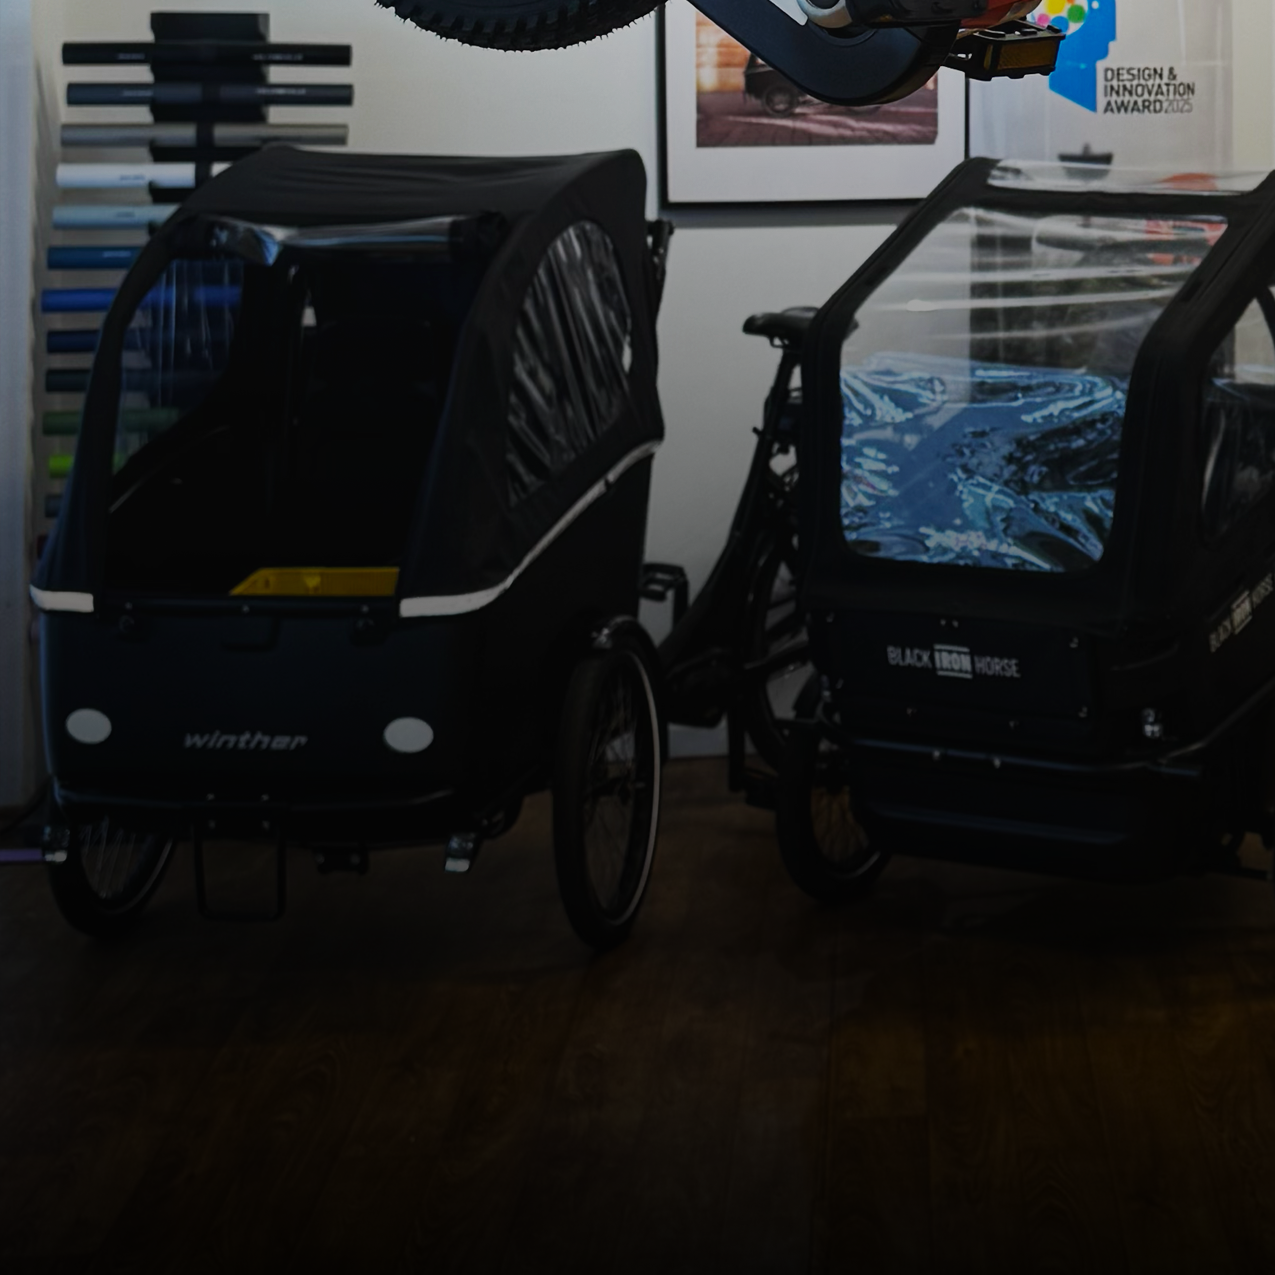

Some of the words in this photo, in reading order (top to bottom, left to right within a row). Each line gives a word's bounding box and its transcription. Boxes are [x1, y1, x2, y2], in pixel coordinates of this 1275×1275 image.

[1104, 67, 1164, 82] DESIGN
[1167, 66, 1178, 81] &
[1103, 82, 1195, 97] INNOVATION
[887, 645, 932, 669] BLACK
[934, 651, 972, 672] IRON
[974, 654, 1021, 678] HORSE
[183, 729, 309, 751] winther
